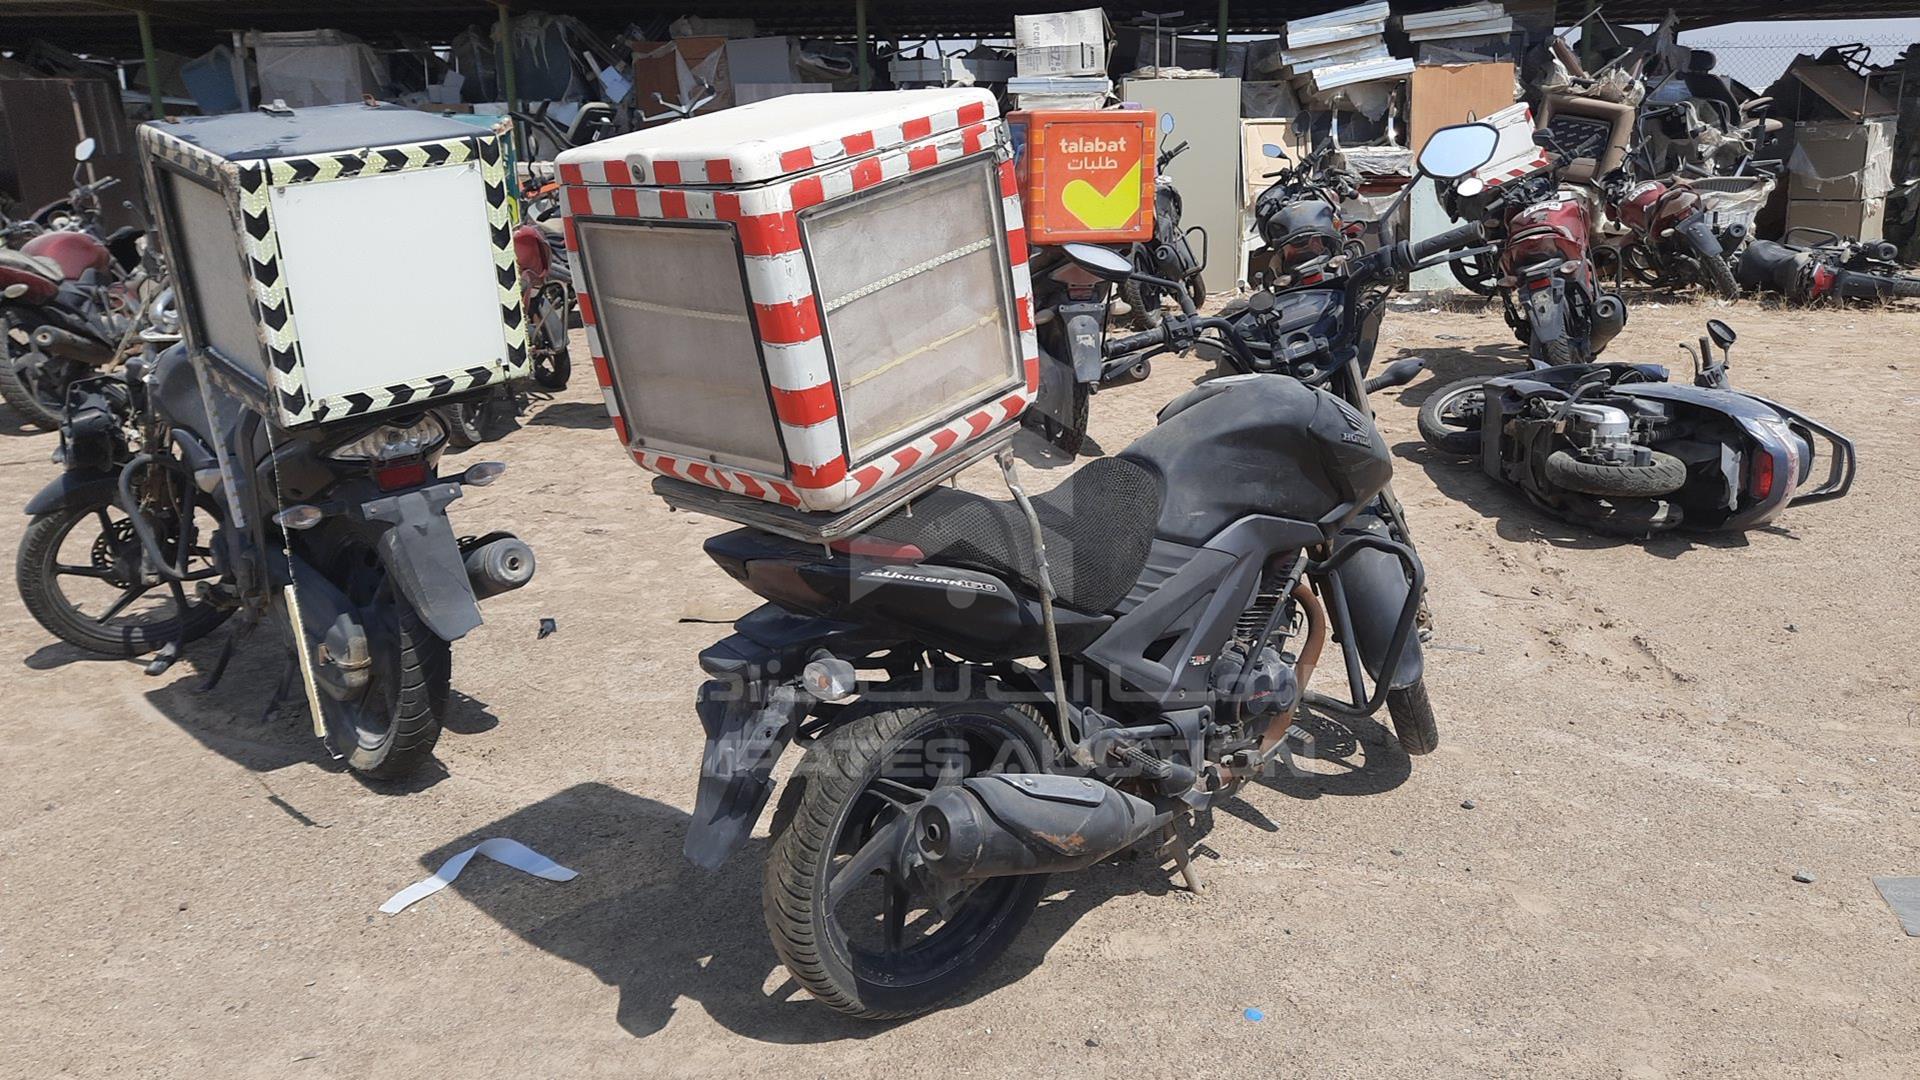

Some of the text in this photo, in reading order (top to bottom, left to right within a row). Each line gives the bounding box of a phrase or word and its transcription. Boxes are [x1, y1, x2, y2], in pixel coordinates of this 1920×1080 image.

[1059, 136, 1127, 154] talabat
[1067, 156, 1118, 174] طلبات
[1341, 432, 1371, 447] HONDA
